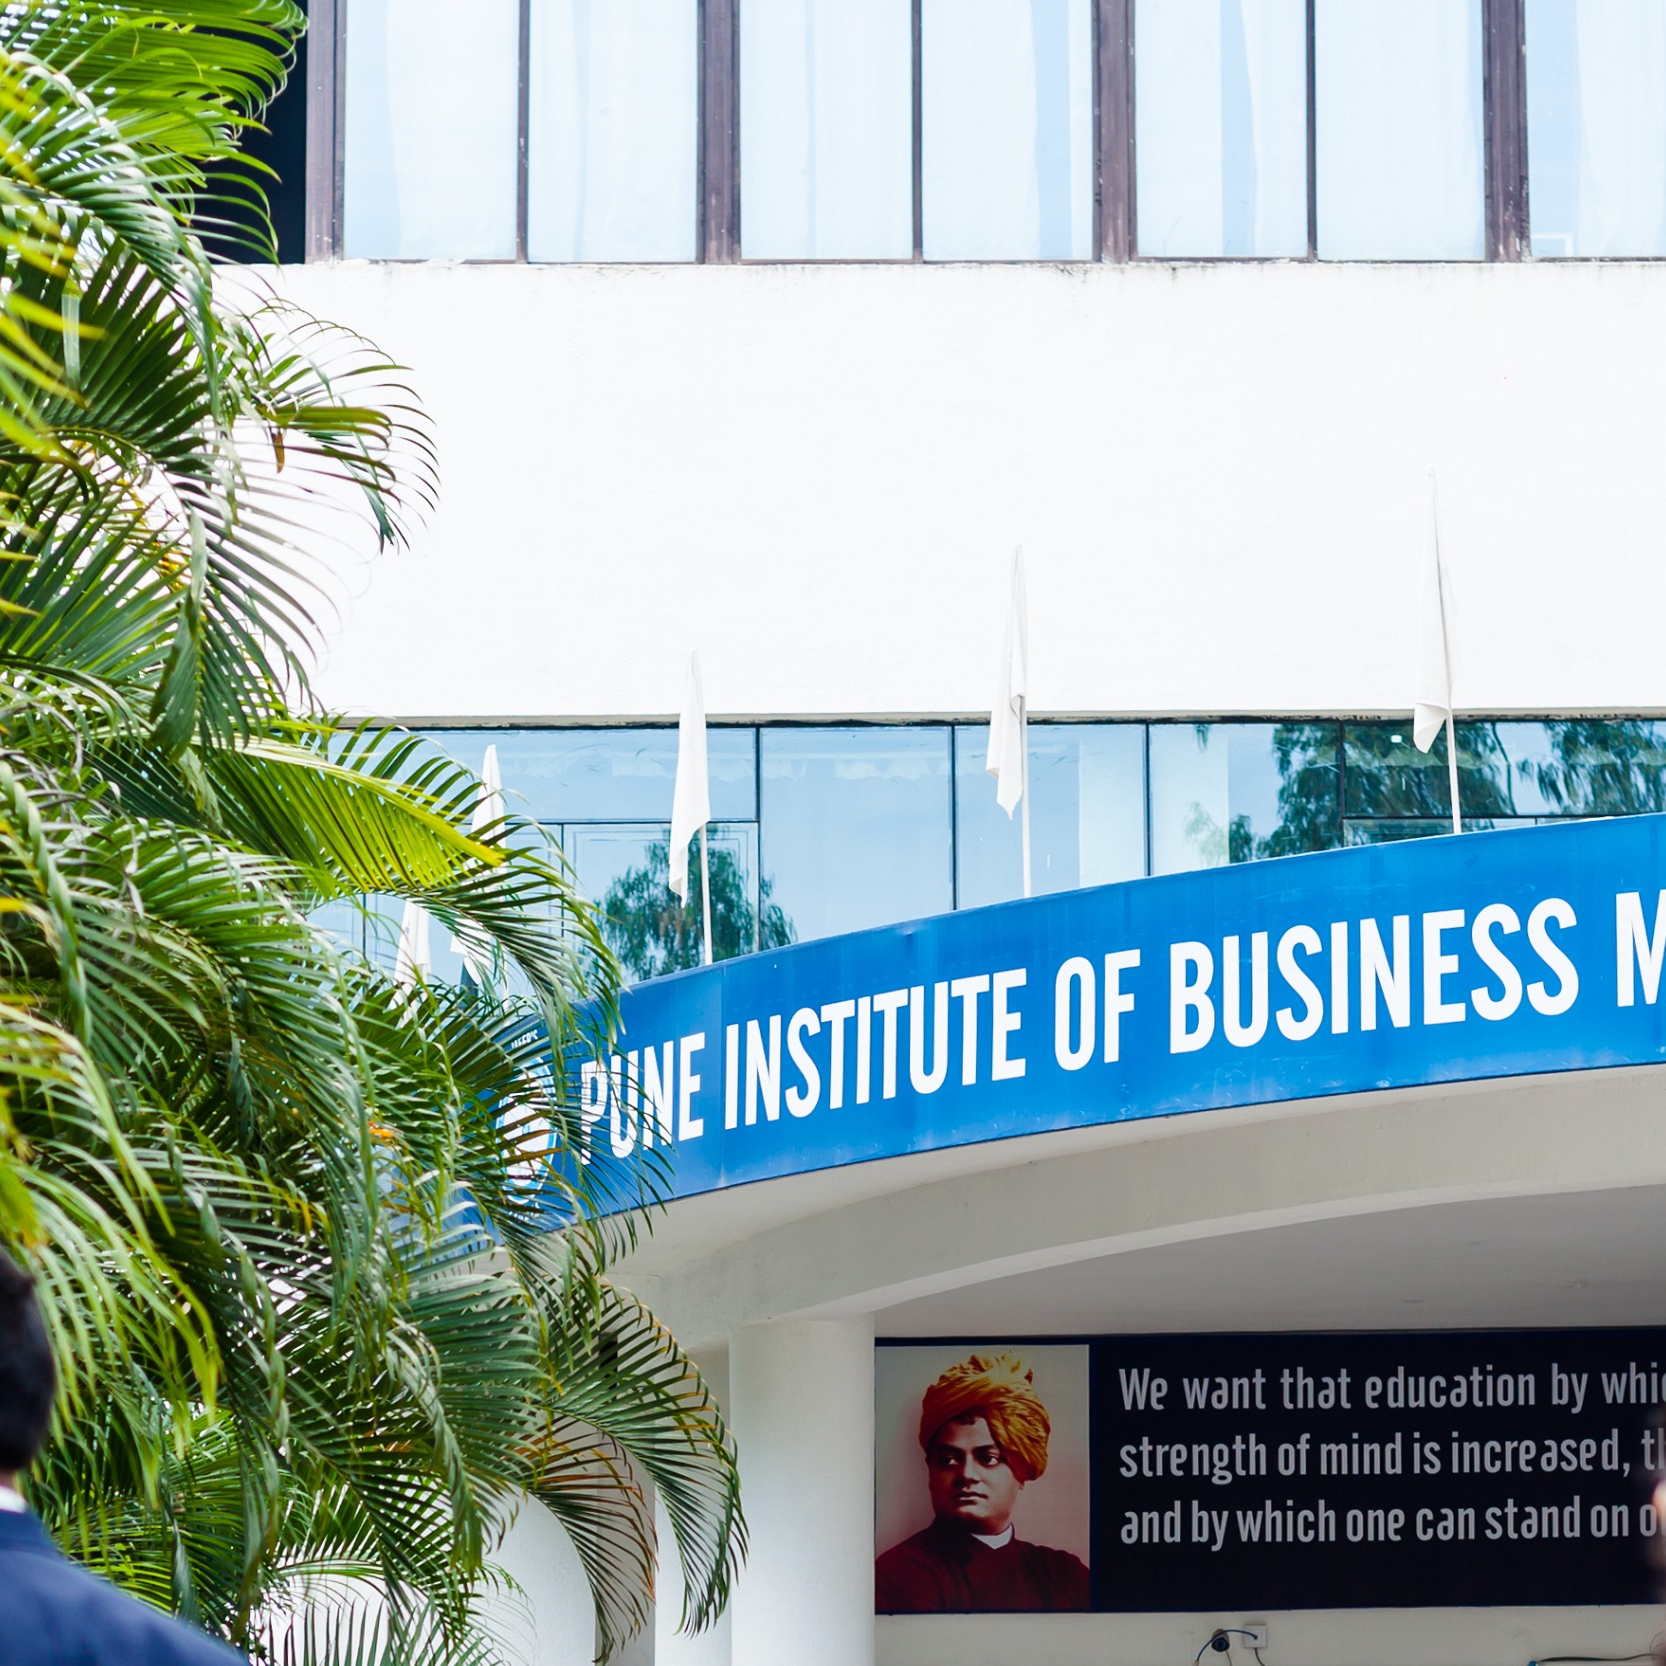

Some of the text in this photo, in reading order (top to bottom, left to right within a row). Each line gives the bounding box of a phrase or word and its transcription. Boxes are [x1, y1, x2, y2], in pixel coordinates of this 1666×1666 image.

[580, 1032, 705, 1165] PUNE
[725, 968, 1028, 1130] INSTITUTE
[1054, 949, 1141, 1071] OF
[1170, 897, 1579, 1055] BUSINESS
[1119, 1368, 1168, 1410] We
[1183, 1369, 1266, 1409] want
[1280, 1367, 1351, 1409] that
[1365, 1365, 1536, 1408] education
[1551, 1363, 1589, 1413] by
[1119, 1433, 1267, 1485] strength
[1278, 1433, 1310, 1475] of
[1320, 1432, 1403, 1474] mind
[1414, 1432, 1441, 1474] is
[1451, 1429, 1630, 1477] increased,
[1120, 1501, 1181, 1544] and
[1191, 1500, 1229, 1551] by
[1236, 1500, 1336, 1542] which
[1346, 1509, 1406, 1542] one
[1416, 1508, 1476, 1541] can
[1485, 1495, 1581, 1539] stand
[1590, 1504, 1630, 1538] on
